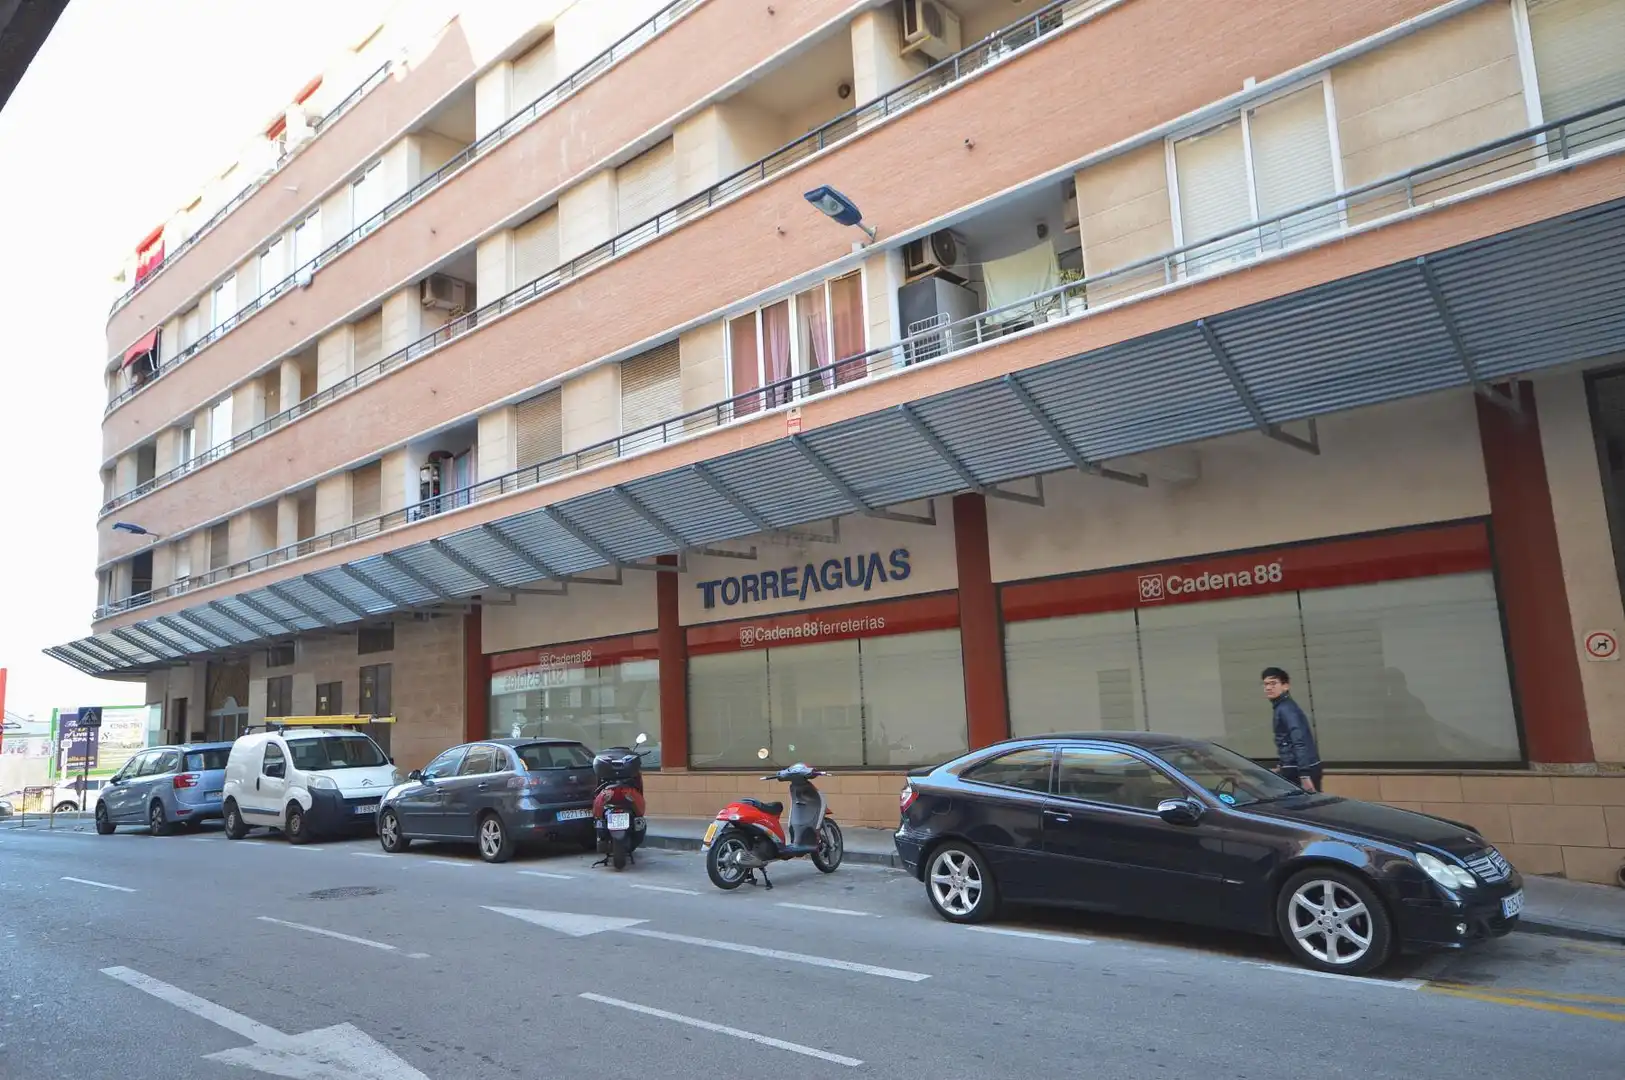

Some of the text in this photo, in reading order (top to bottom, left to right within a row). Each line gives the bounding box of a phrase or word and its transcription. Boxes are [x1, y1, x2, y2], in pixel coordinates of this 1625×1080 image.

[697, 548, 911, 608] TORREAGUAS
[1166, 571, 1253, 595] Cadena
[1254, 563, 1282, 584] 88
[755, 625, 802, 642] Cadena
[550, 653, 581, 667] Cadena
[581, 650, 592, 663] 88
